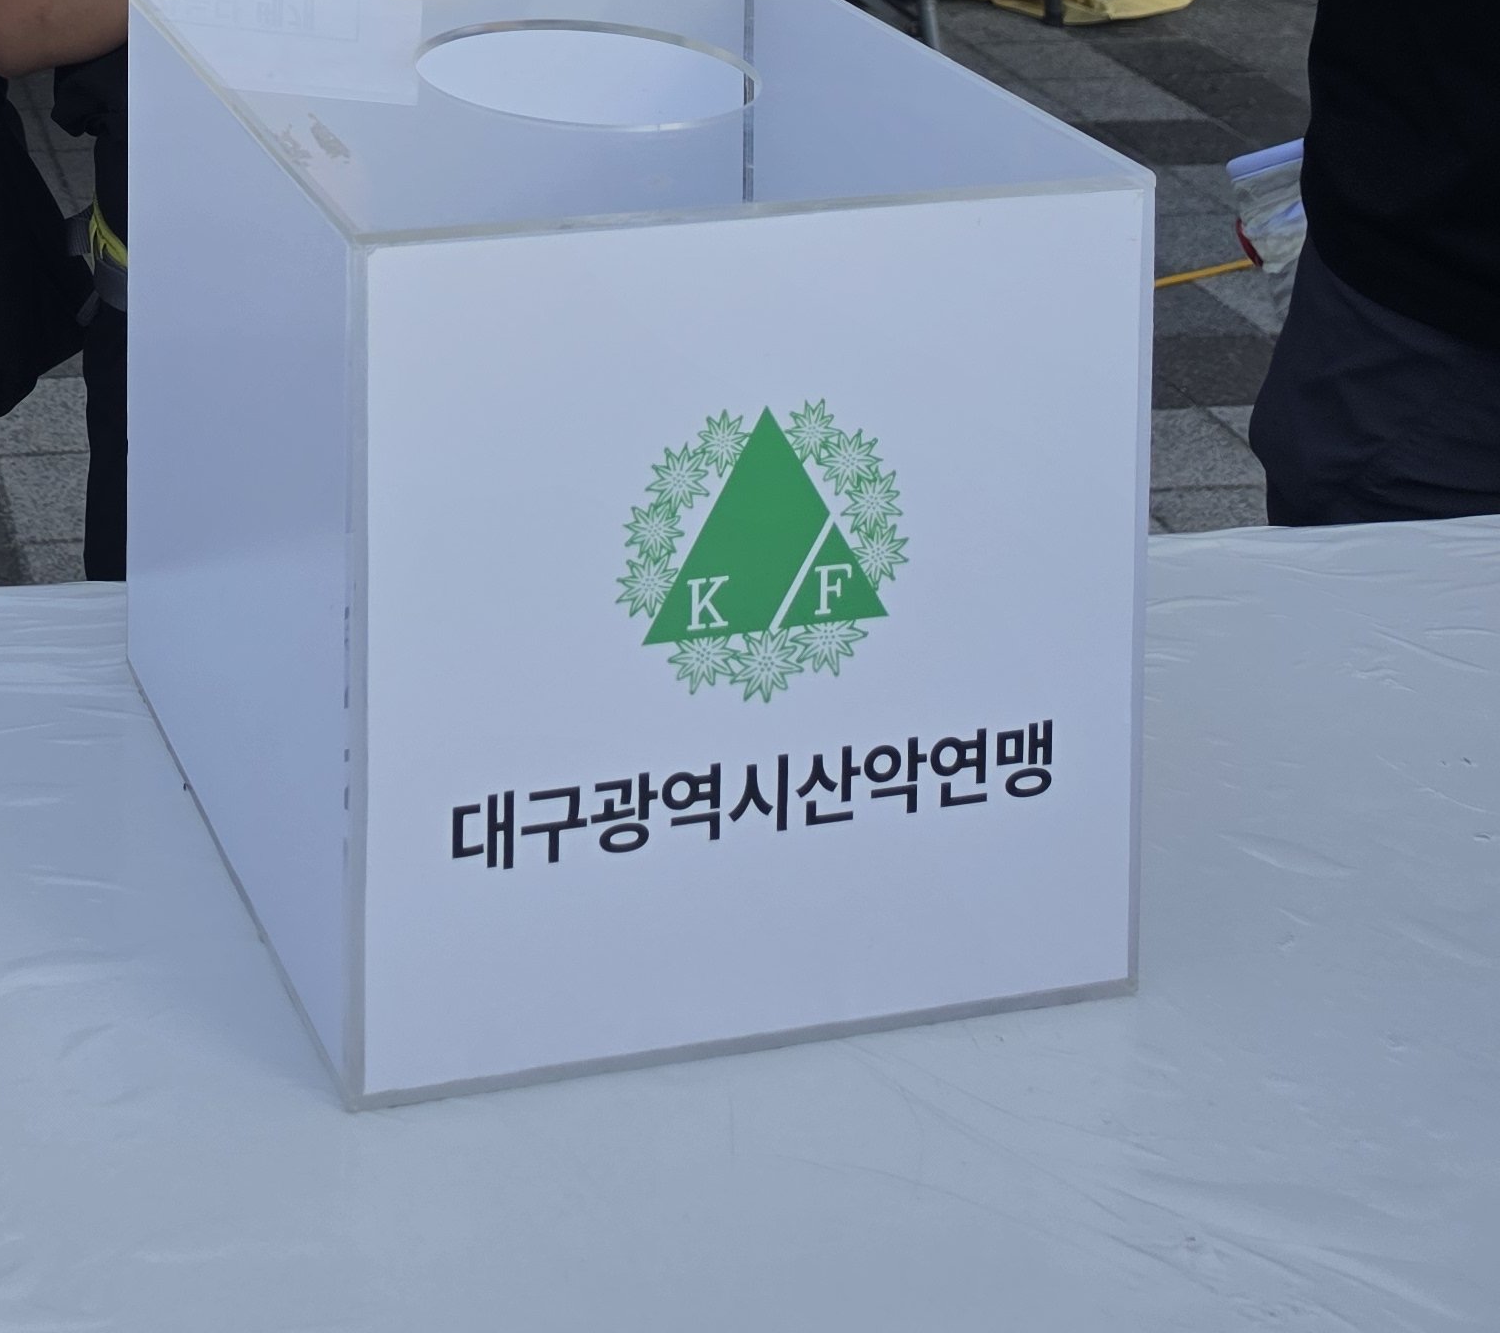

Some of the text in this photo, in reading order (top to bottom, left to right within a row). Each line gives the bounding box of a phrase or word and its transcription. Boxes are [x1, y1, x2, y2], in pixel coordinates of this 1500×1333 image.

[685, 564, 854, 631] K F
[450, 718, 1057, 871] 대구광역시산악연맹
